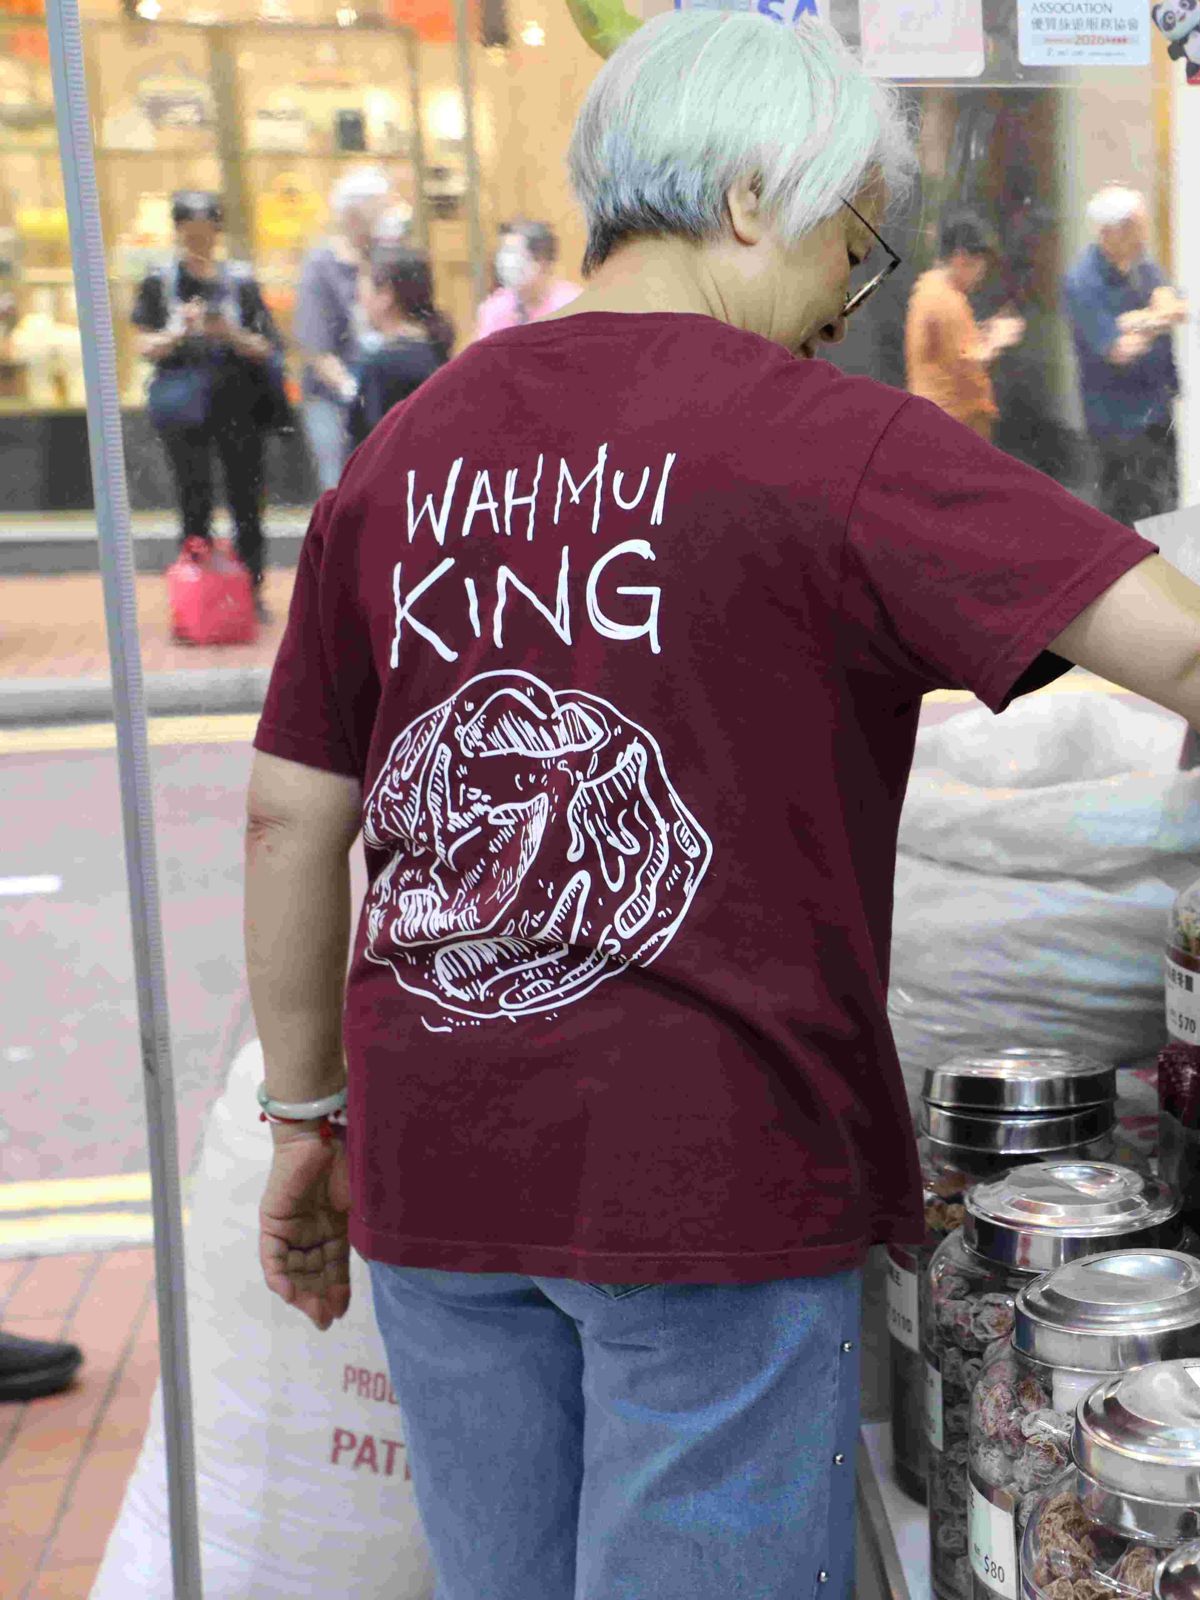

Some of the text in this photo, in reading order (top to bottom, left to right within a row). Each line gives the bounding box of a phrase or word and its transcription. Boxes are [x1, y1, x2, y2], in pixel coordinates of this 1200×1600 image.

[1030, 2, 1113, 14] ASSOCIATION
[390, 538, 661, 669] KING
[1178, 1013, 1196, 1034] $70
[983, 1553, 1006, 1584] $80
